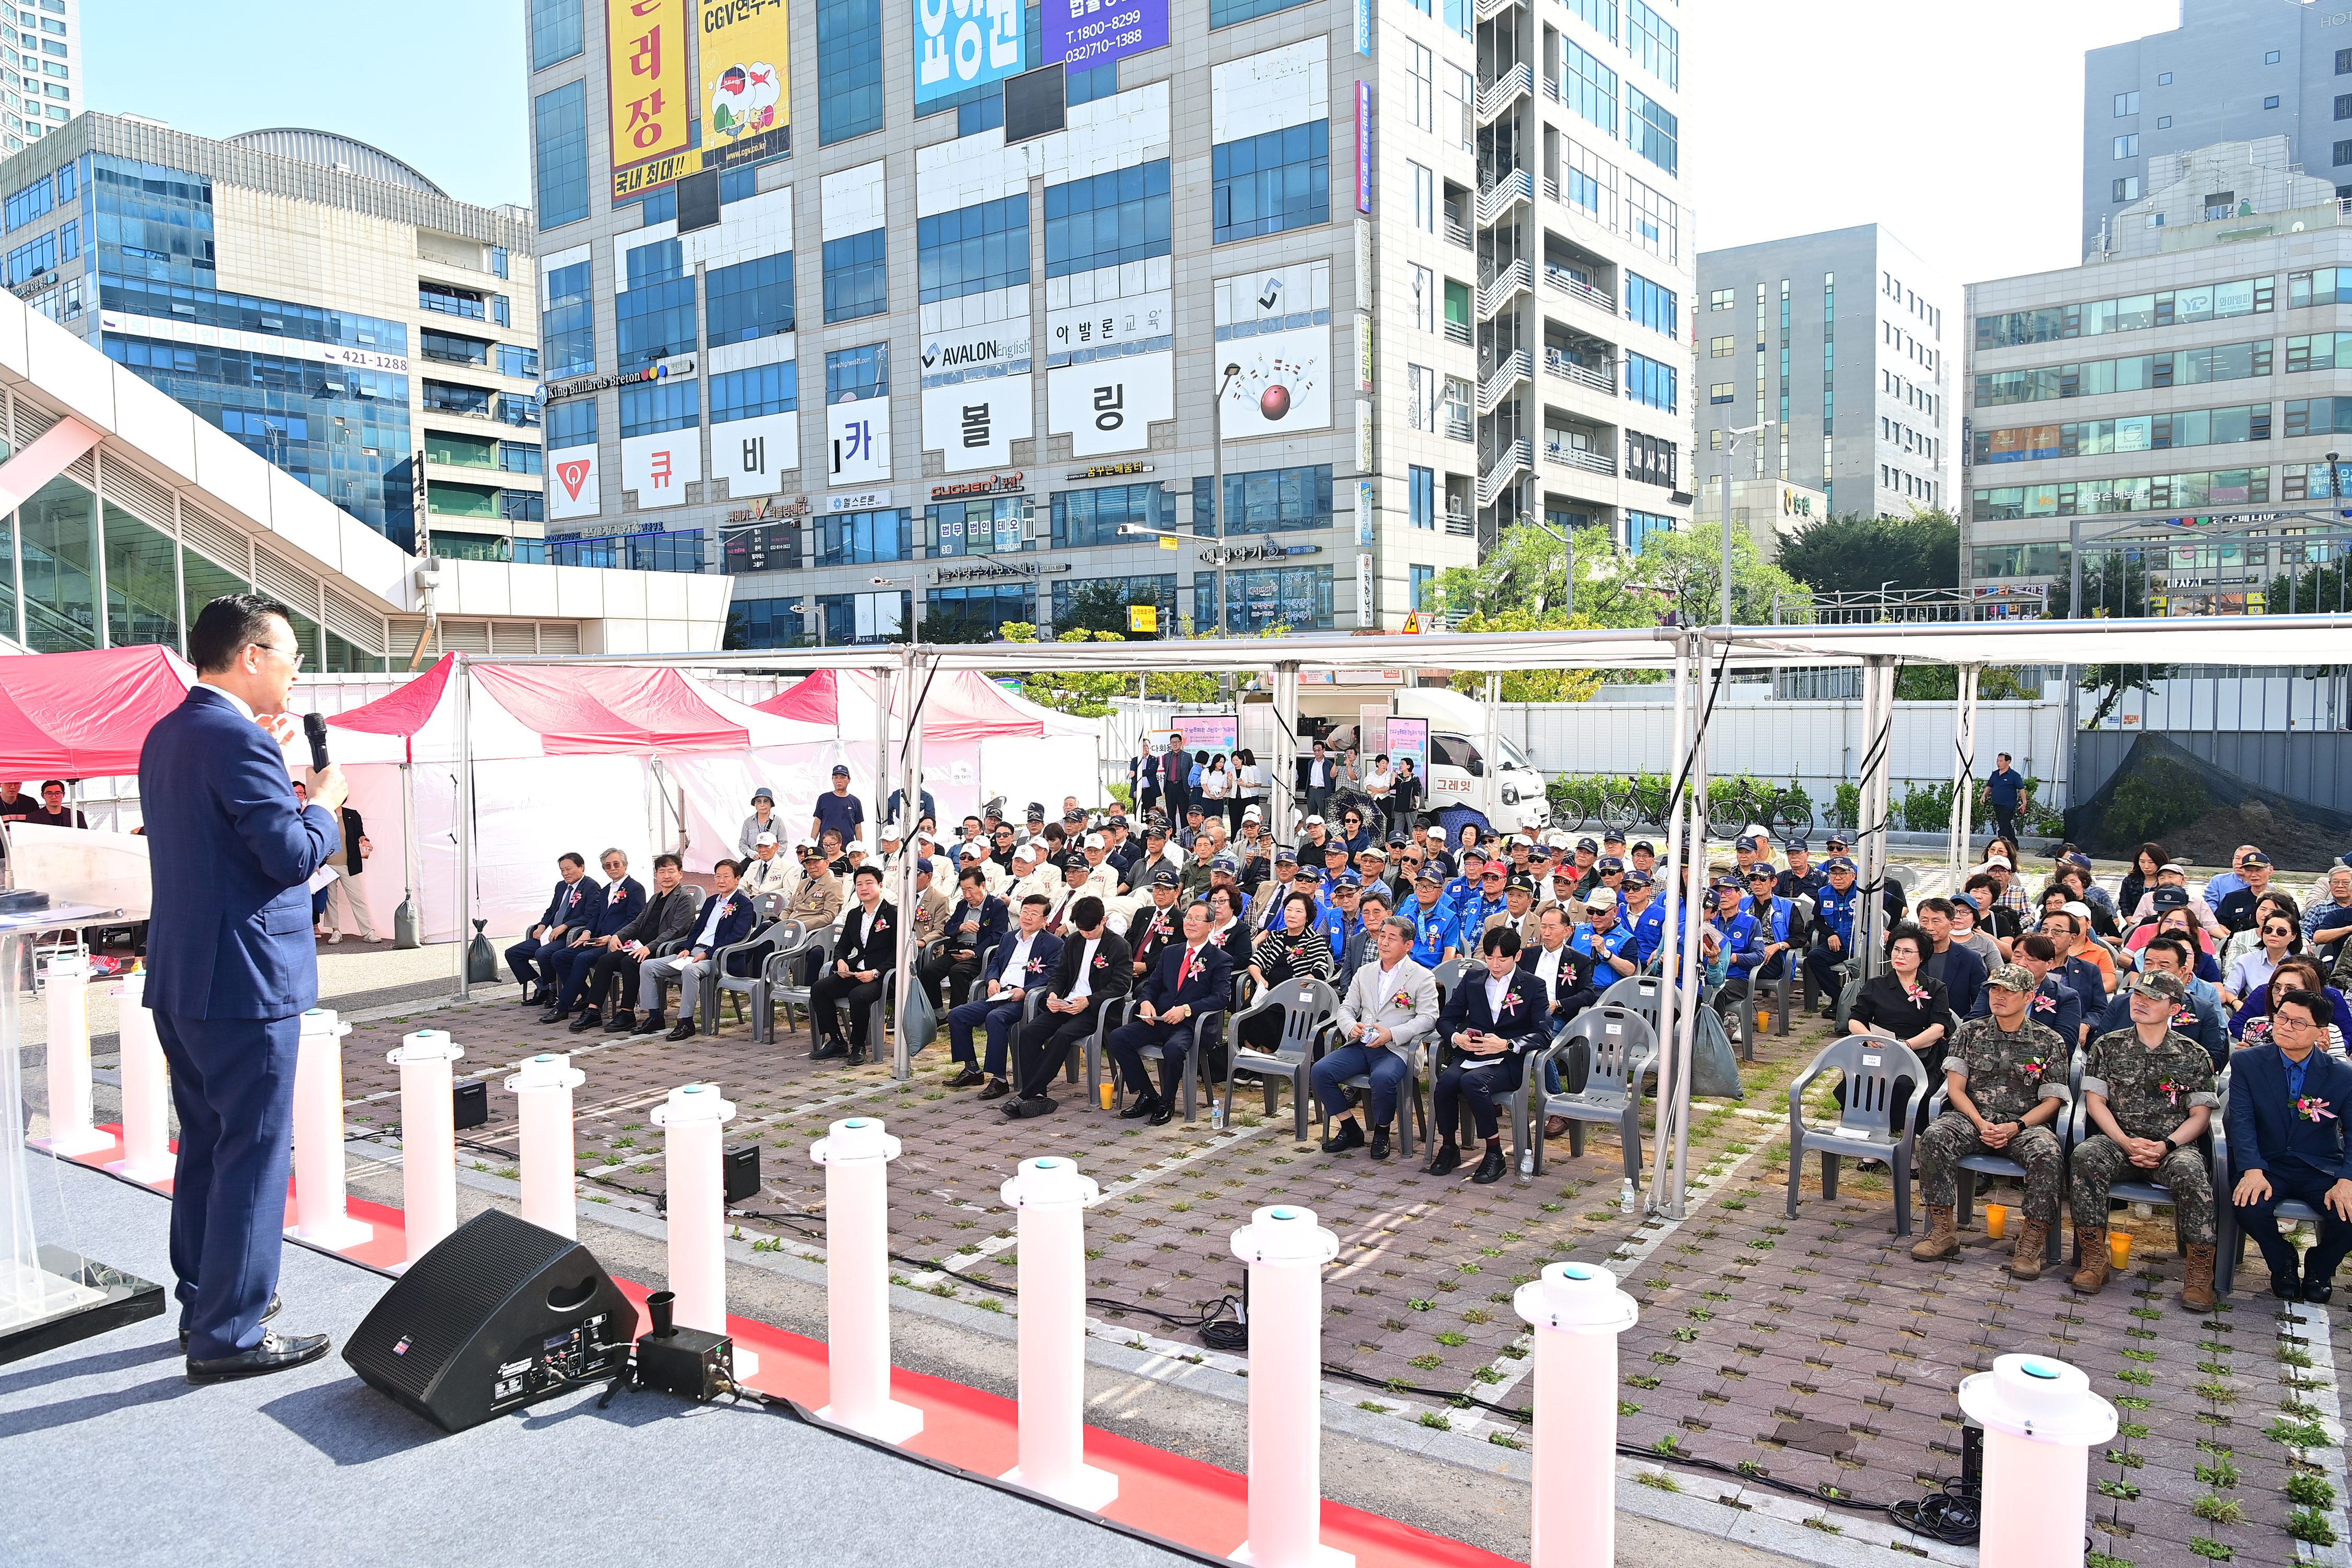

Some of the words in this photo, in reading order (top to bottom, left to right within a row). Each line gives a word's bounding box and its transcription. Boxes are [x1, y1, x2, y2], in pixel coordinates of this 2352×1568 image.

[1066, 10, 1140, 44] T.1800-8299
[1065, 29, 1142, 63] 032)710-1388
[625, 0, 666, 149] 러장
[727, 142, 766, 160] www.cgv.co.kr
[616, 167, 642, 193] 국내
[646, 155, 685, 185] 최대!!
[1362, 162, 1368, 188] 테오
[2220, 294, 2250, 307] 와이엘피
[942, 339, 997, 367] AVALON
[342, 351, 408, 372] 421-1288
[829, 357, 871, 370] www.highest21.com
[547, 385, 568, 399] King
[569, 376, 607, 395] Billiards
[609, 372, 640, 386] Breton
[651, 451, 672, 489] 큐
[743, 436, 765, 475] 비
[845, 420, 871, 461] 카
[962, 403, 991, 448] 볼
[1094, 384, 1124, 431] 링
[1633, 445, 1667, 475] 마사지
[2313, 467, 2327, 476] 우리
[2310, 476, 2330, 486] 컴퓨터
[2313, 486, 2326, 495] 학원
[844, 494, 875, 508] 헬스트론
[942, 522, 989, 536] 법무법인
[997, 520, 1018, 531] 테오
[941, 545, 952, 554] 3층
[1287, 546, 1315, 554] T.816-7952
[1285, 573, 1311, 584] 관악기
[2167, 577, 2201, 589] 마사지
[1285, 598, 1312, 609] 우쿨렐레
[1286, 610, 1312, 622] 각종악기
[1437, 779, 1470, 792] 그레잇
